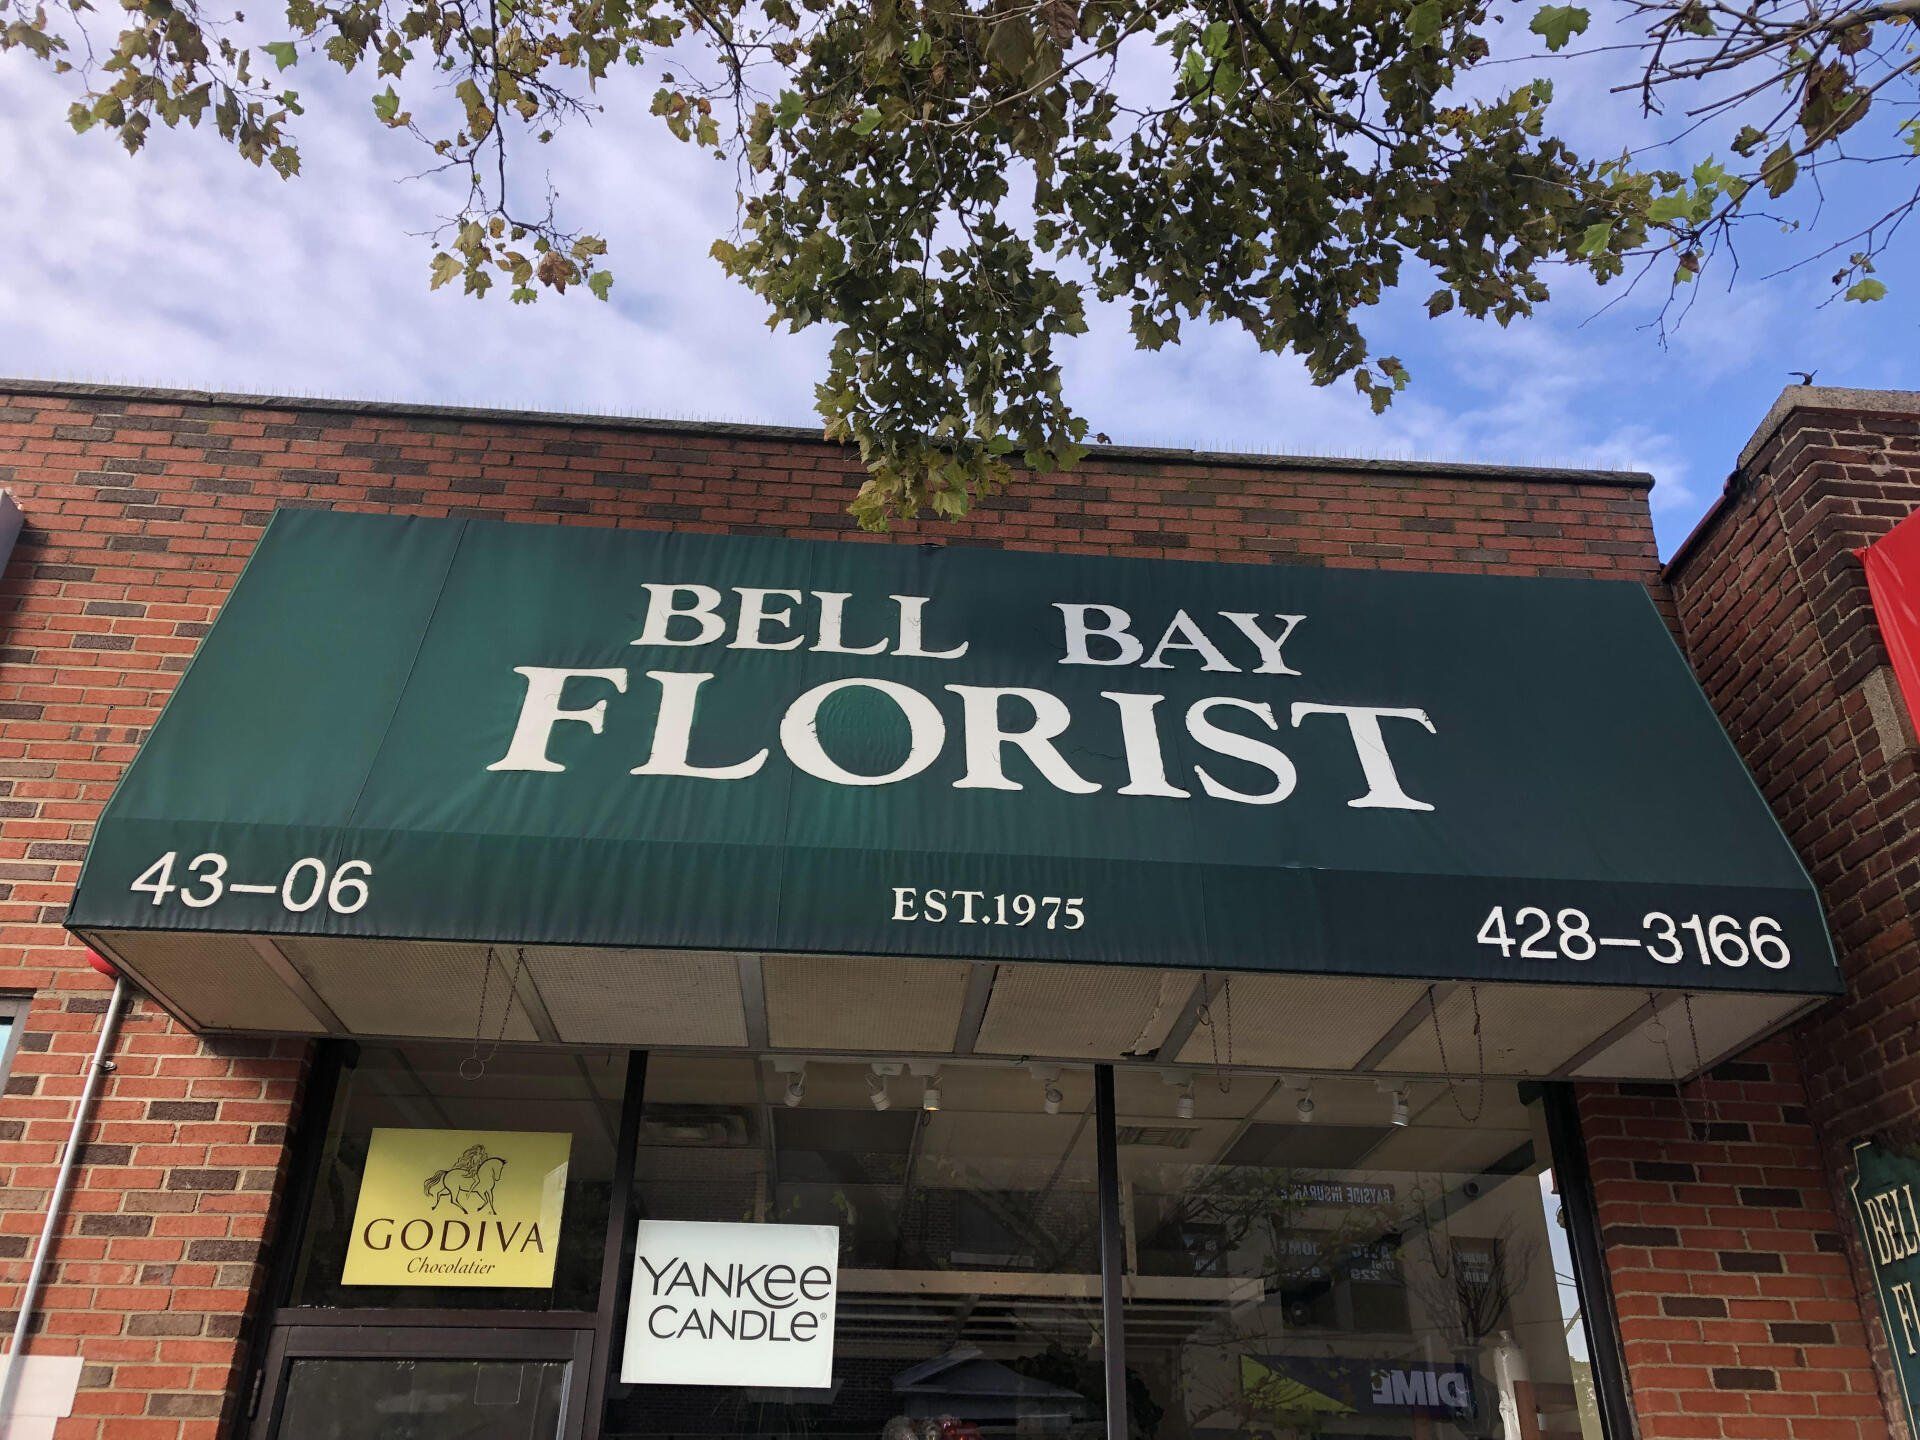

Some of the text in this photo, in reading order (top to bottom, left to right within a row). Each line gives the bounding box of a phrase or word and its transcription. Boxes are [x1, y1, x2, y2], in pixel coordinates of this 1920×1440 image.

[630, 582, 1308, 676] BELL BAY
[485, 665, 1438, 813] FLORIST
[130, 851, 373, 915] 43-06
[891, 887, 1086, 931] EST.1975
[1476, 905, 1791, 970] 428-3166
[363, 1218, 544, 1253] GODIVA
[407, 1256, 496, 1275] Chocolatier
